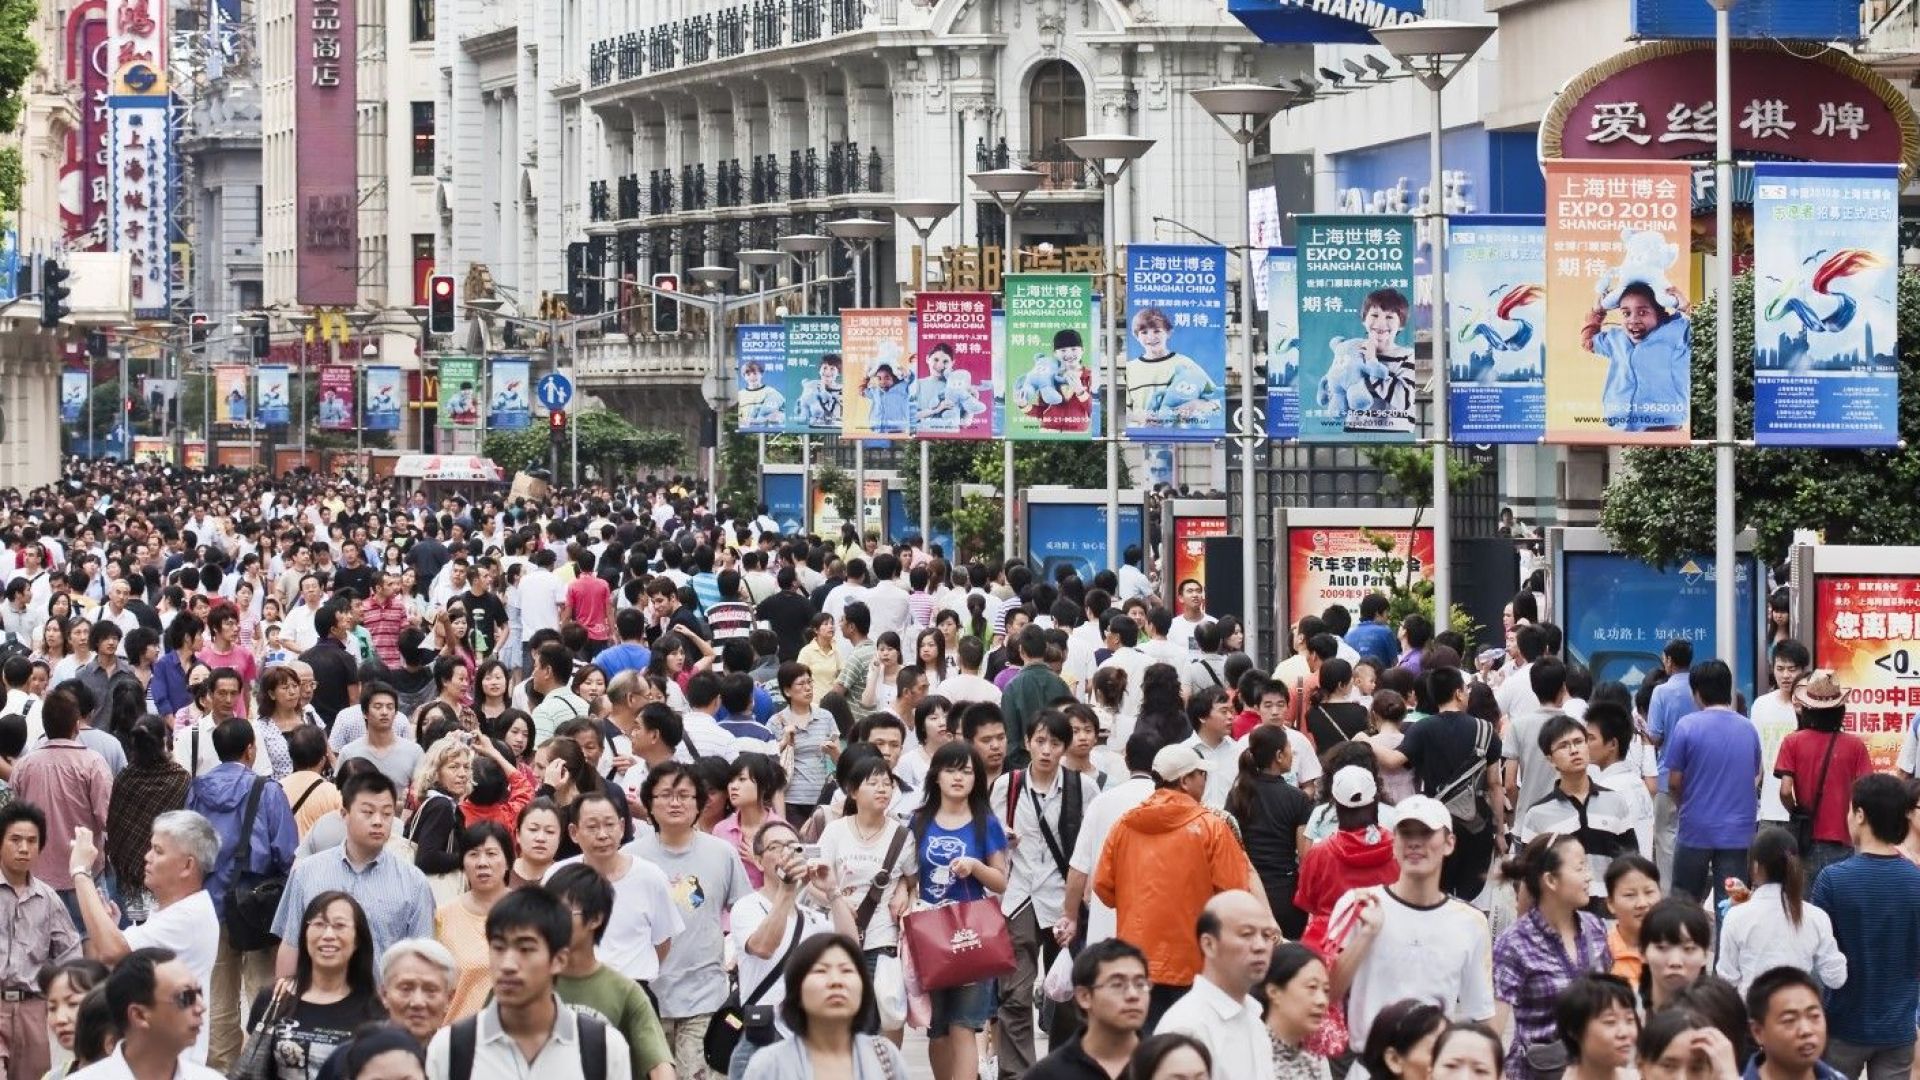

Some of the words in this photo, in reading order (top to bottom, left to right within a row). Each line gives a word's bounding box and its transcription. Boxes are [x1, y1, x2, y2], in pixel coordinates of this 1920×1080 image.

[312, 0, 341, 87] 品商店
[1558, 176, 1677, 199] 上海世博会
[1558, 201, 1614, 217] EXPO
[1619, 202, 1678, 219] 2010
[1559, 219, 1632, 231] SHANGHAI
[1634, 220, 1678, 232] CHINA
[1306, 228, 1402, 246] 上海世博会
[1306, 248, 1352, 261] EXPO
[1355, 247, 1404, 261] 2010
[1133, 256, 1216, 271] 上海世博会
[1306, 262, 1366, 272] SHANGHAI
[1367, 262, 1403, 272] CHINA
[1133, 272, 1172, 284] EXPO
[1175, 273, 1217, 285] 2010
[1012, 285, 1083, 298] 上海世博会
[1134, 284, 1184, 293] SHANGHAI
[1186, 285, 1216, 294] CHINA
[922, 301, 985, 313] 上海世博会
[1012, 299, 1046, 309] EXPO
[1048, 300, 1084, 310] 2010
[922, 314, 952, 323] EXPO
[954, 314, 986, 323] 2010
[1013, 308, 1055, 317] SHANGHAI
[1057, 309, 1083, 317] CHINA
[847, 327, 874, 336] EXPO
[876, 328, 904, 337] 2010
[922, 322, 961, 330] SHANGHAI
[1329, 574, 1359, 587] Auto
[1594, 626, 1646, 641] 成功路上
[1844, 686, 1920, 706] 009中国
